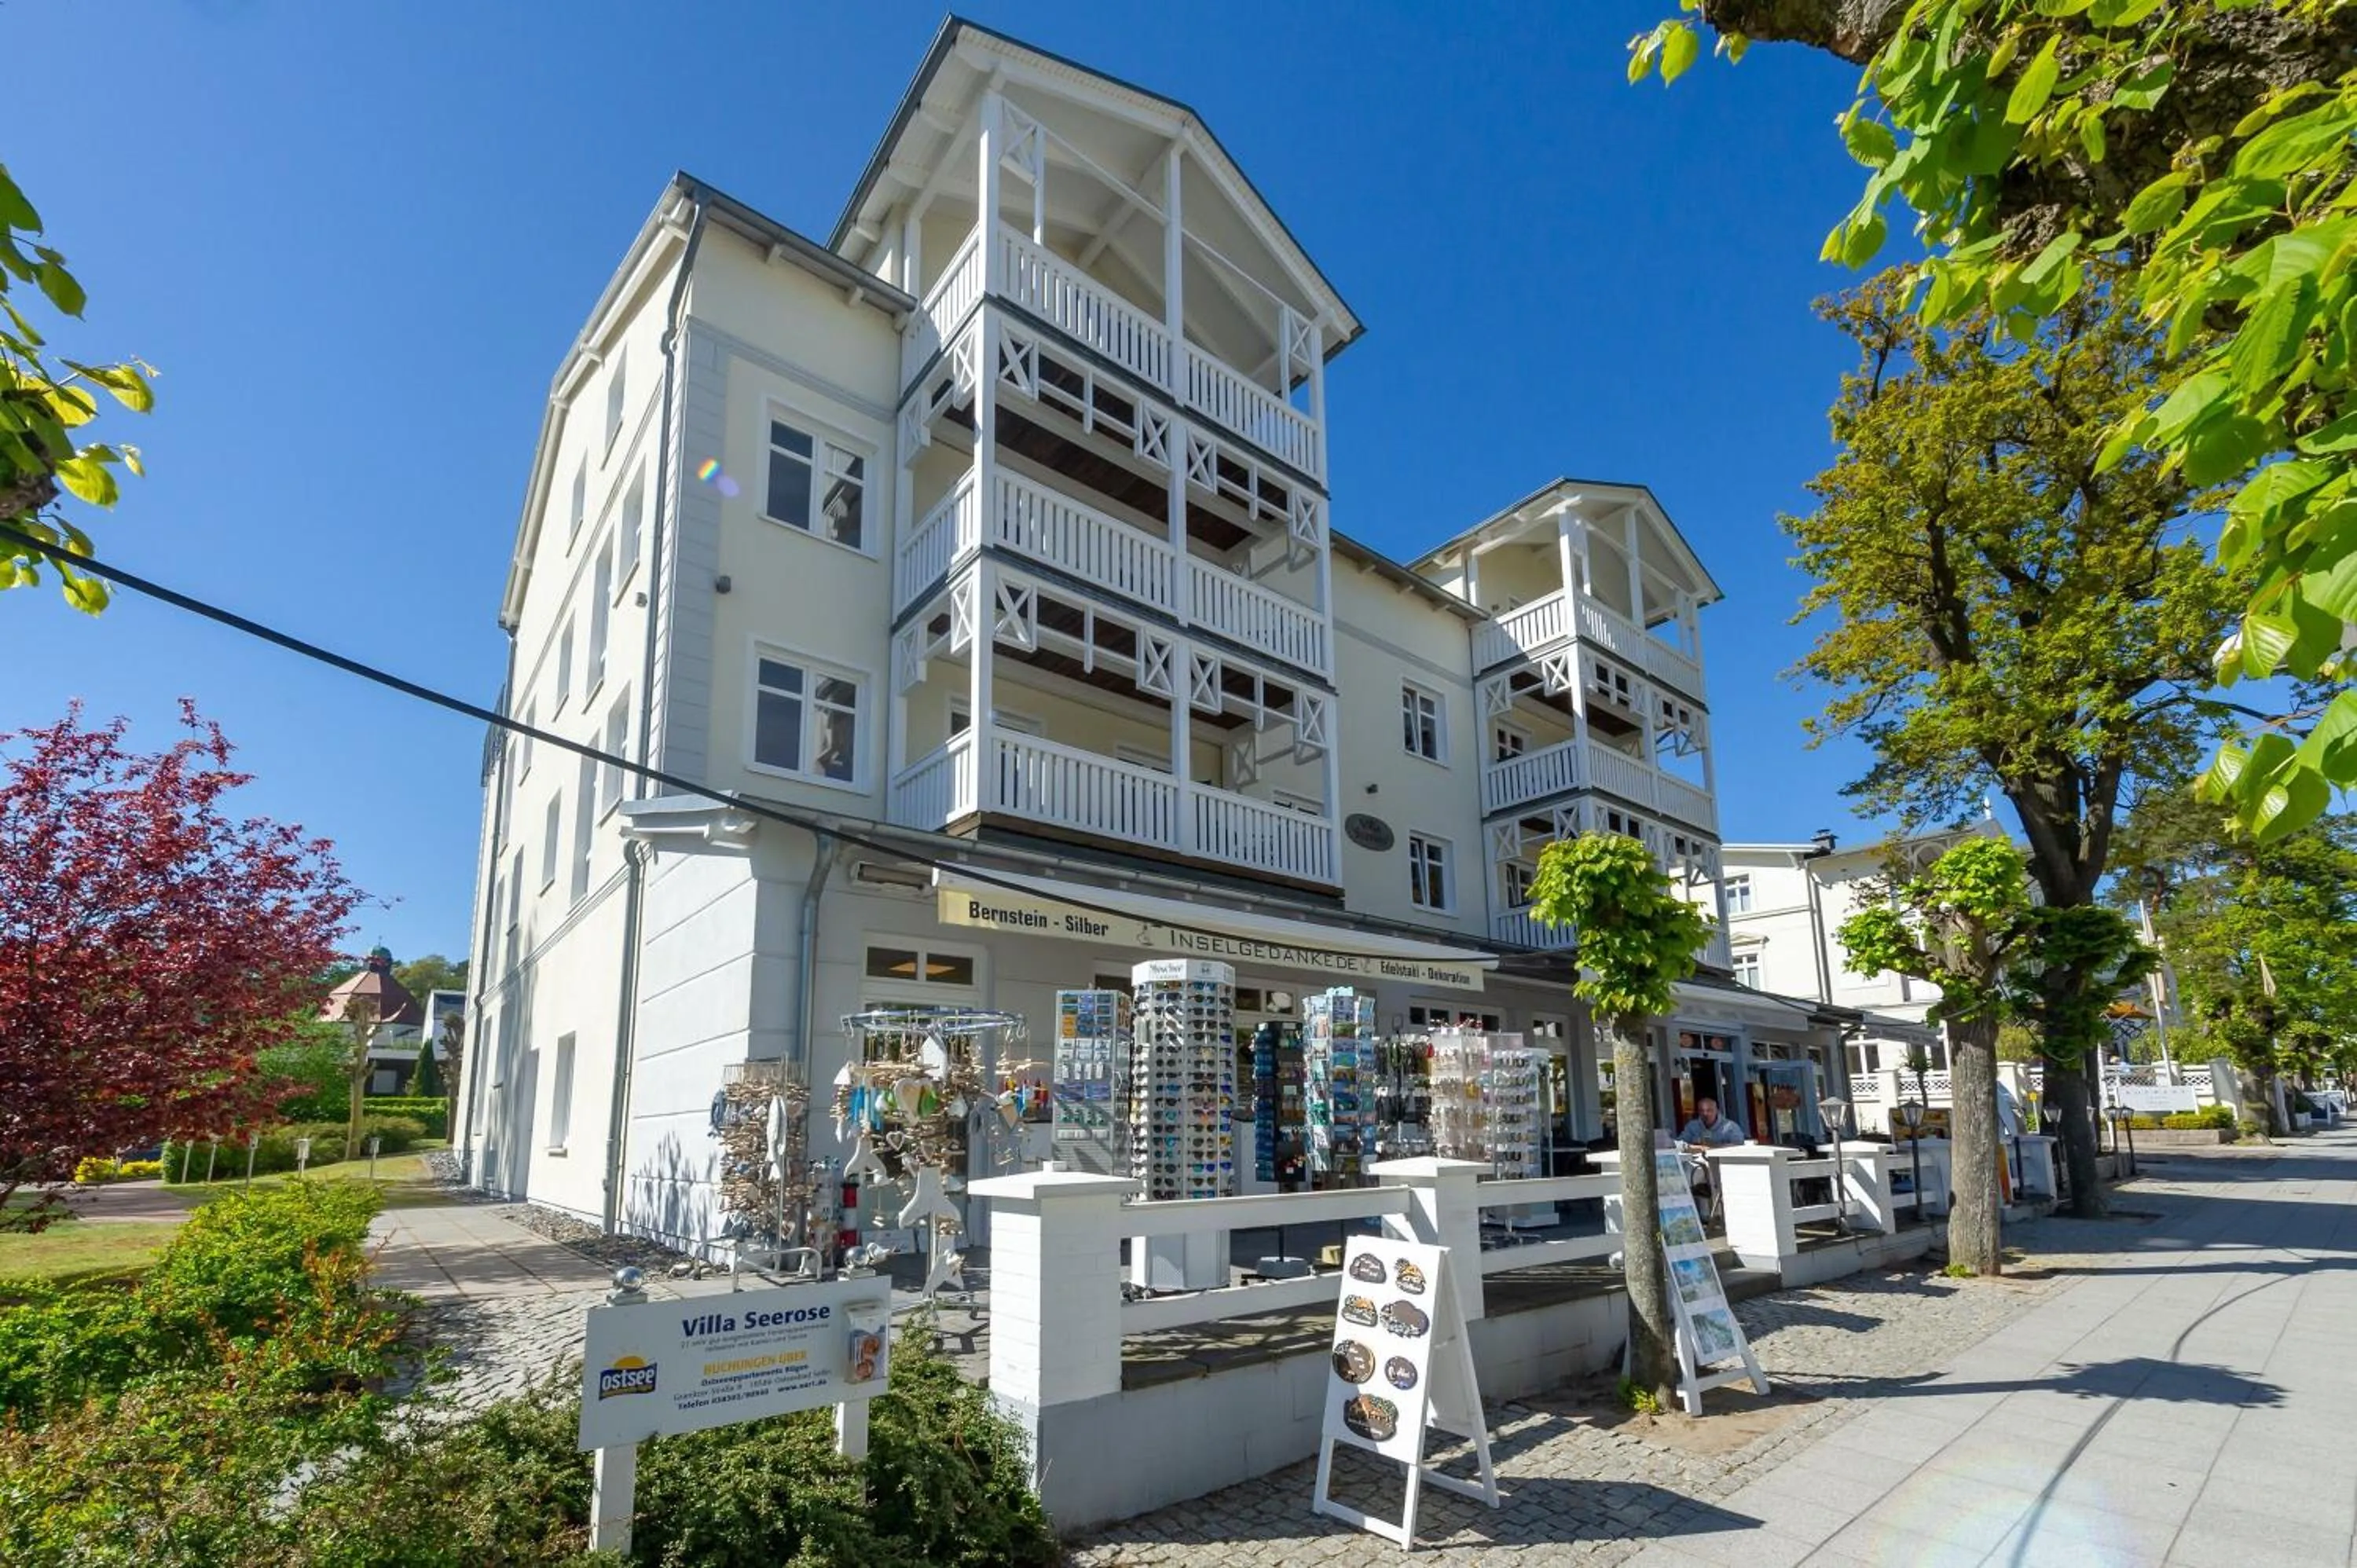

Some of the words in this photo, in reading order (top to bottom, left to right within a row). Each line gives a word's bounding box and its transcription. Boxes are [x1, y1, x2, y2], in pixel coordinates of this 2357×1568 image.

[969, 901, 1047, 928] Bernstein
[1065, 914, 1109, 936] Silber
[1380, 961, 1419, 978] Edelstahl
[1428, 967, 1470, 984] Dekoration
[682, 1313, 735, 1337] Villa
[744, 1306, 830, 1329] Seerose
[602, 1368, 654, 1390] ostsee
